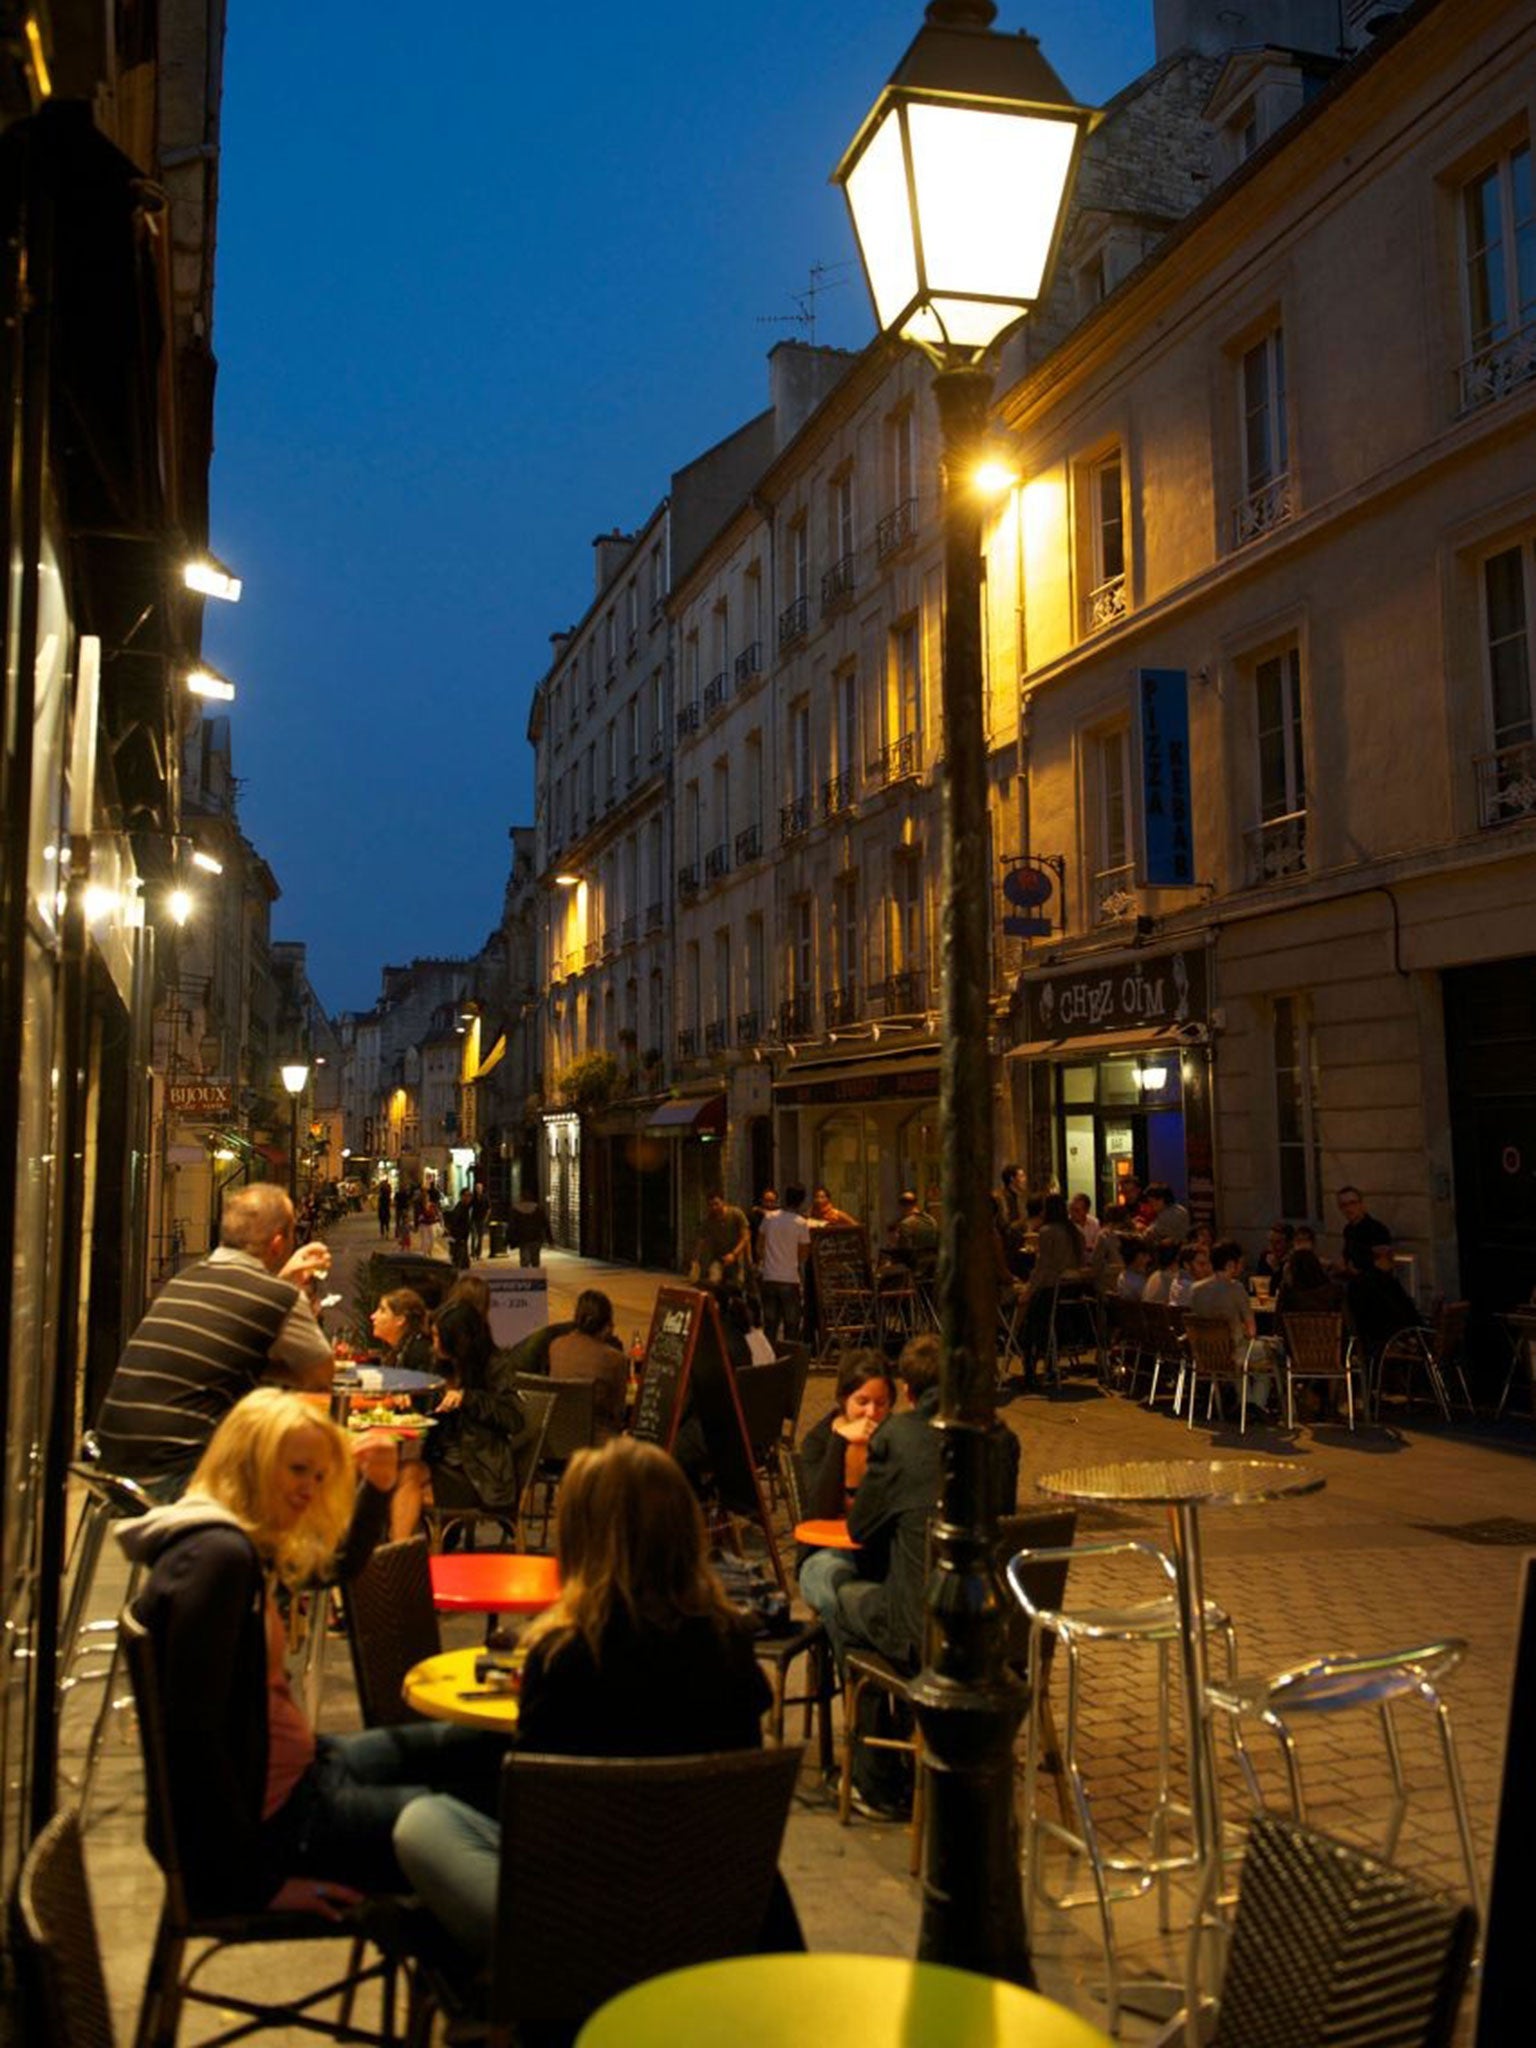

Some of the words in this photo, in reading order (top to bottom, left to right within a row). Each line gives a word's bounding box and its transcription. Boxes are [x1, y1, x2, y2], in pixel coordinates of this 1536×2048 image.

[1144, 678, 1162, 815] PIZZA
[1169, 740, 1187, 877] KEBAB
[1060, 979, 1114, 1024] CHEZ
[170, 1087, 227, 1104] BIJOUX
